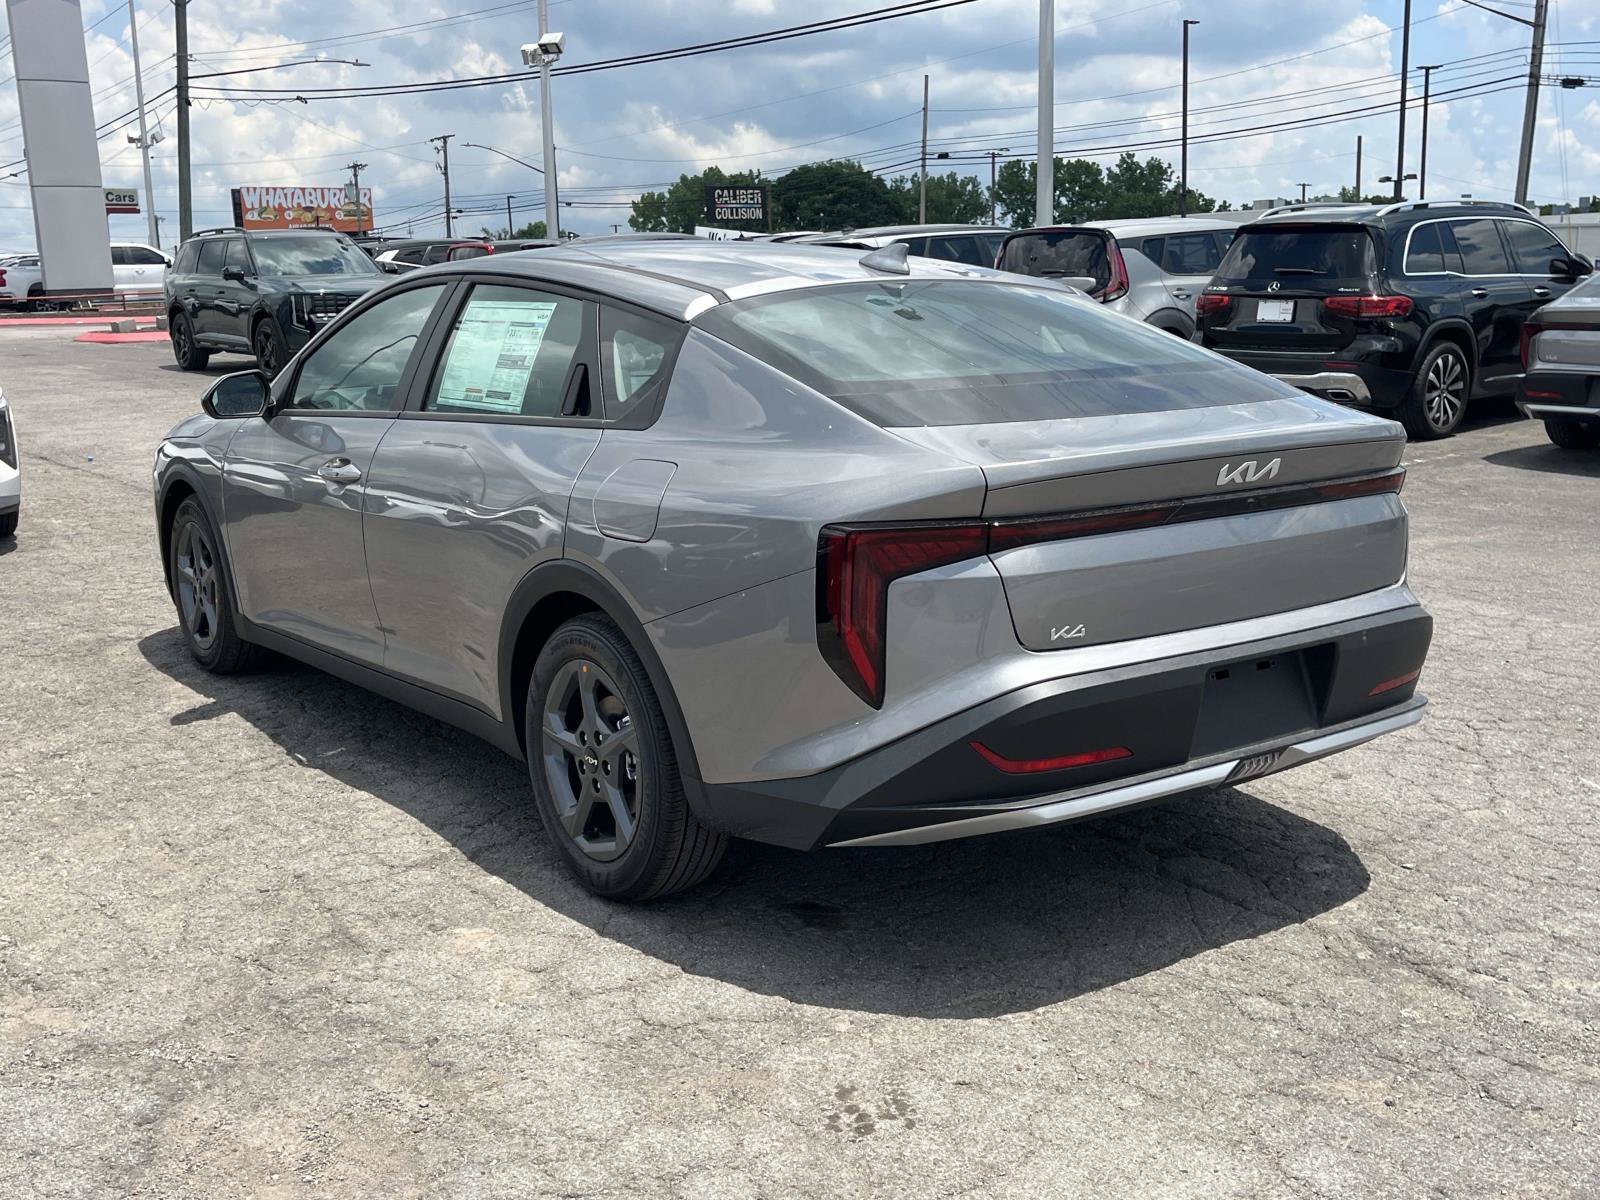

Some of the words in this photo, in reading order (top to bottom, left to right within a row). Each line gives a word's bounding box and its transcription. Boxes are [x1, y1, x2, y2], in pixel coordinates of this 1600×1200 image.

[105, 191, 135, 202] Cars
[714, 189, 762, 204] CALIBER
[715, 207, 763, 220] COLLISION
[1050, 624, 1086, 641] K4
